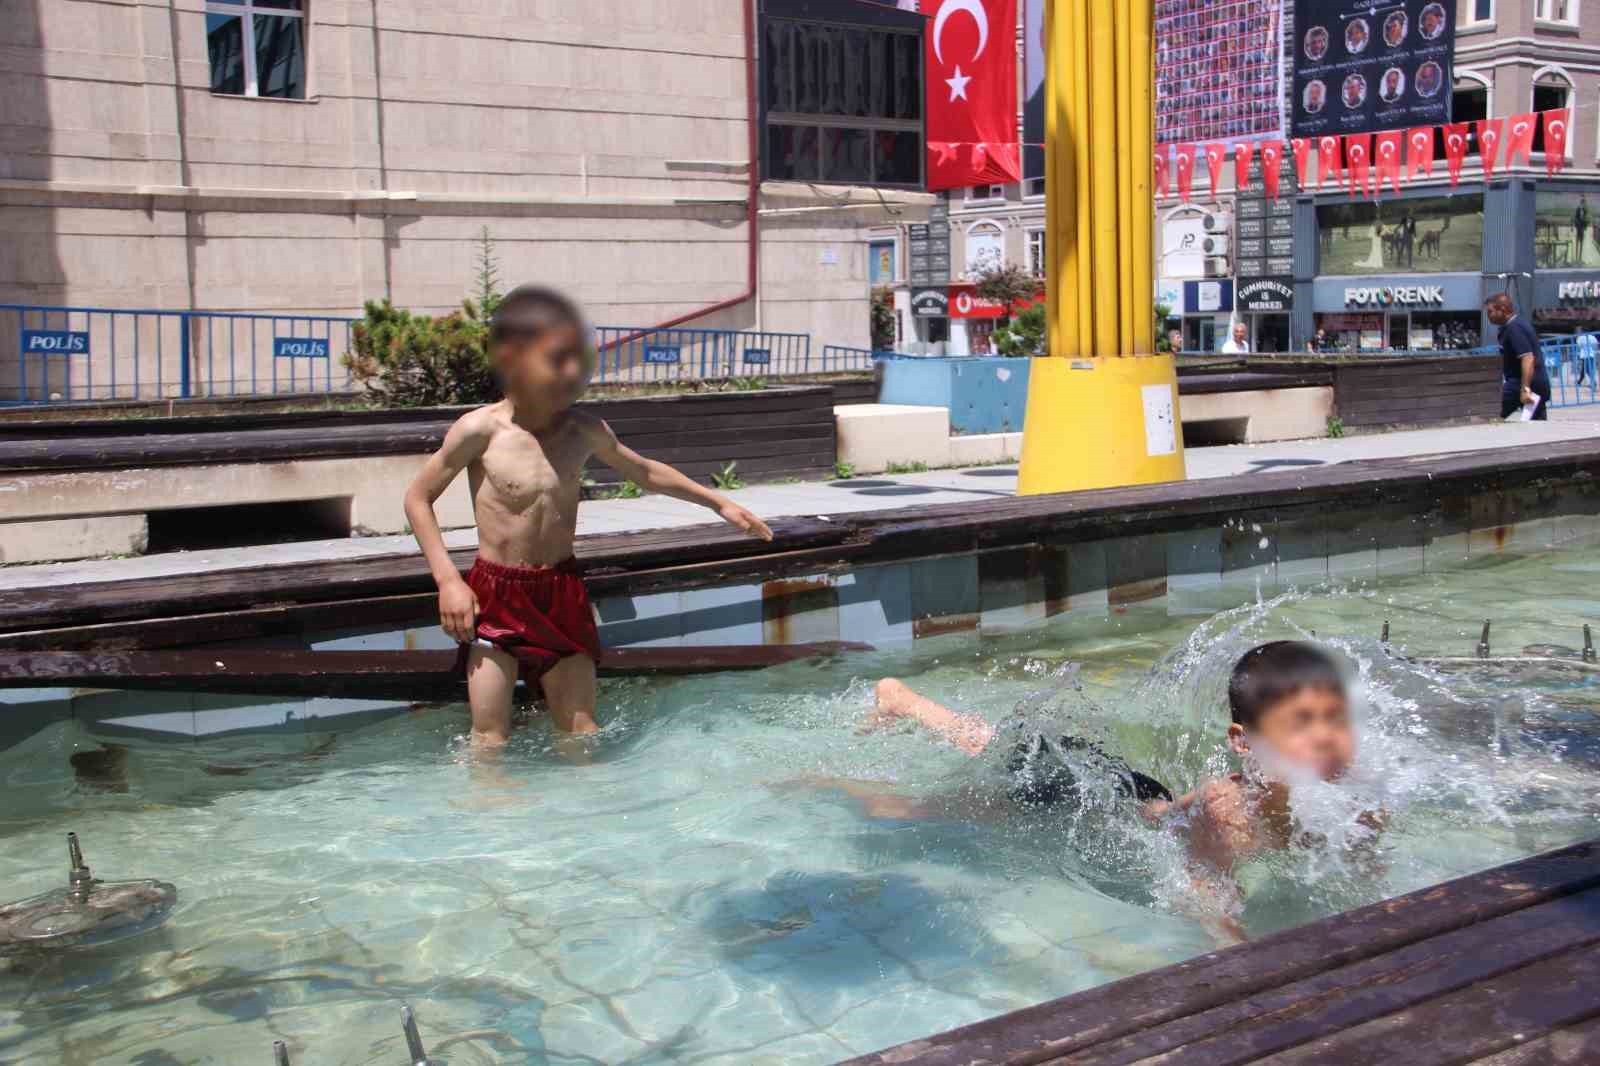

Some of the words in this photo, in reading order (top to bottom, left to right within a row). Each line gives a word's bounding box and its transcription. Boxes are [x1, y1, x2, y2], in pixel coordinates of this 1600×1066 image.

[1344, 285, 1443, 305] FOTORENK
[30, 334, 85, 350] POLİS
[280, 341, 325, 356] POLİS
